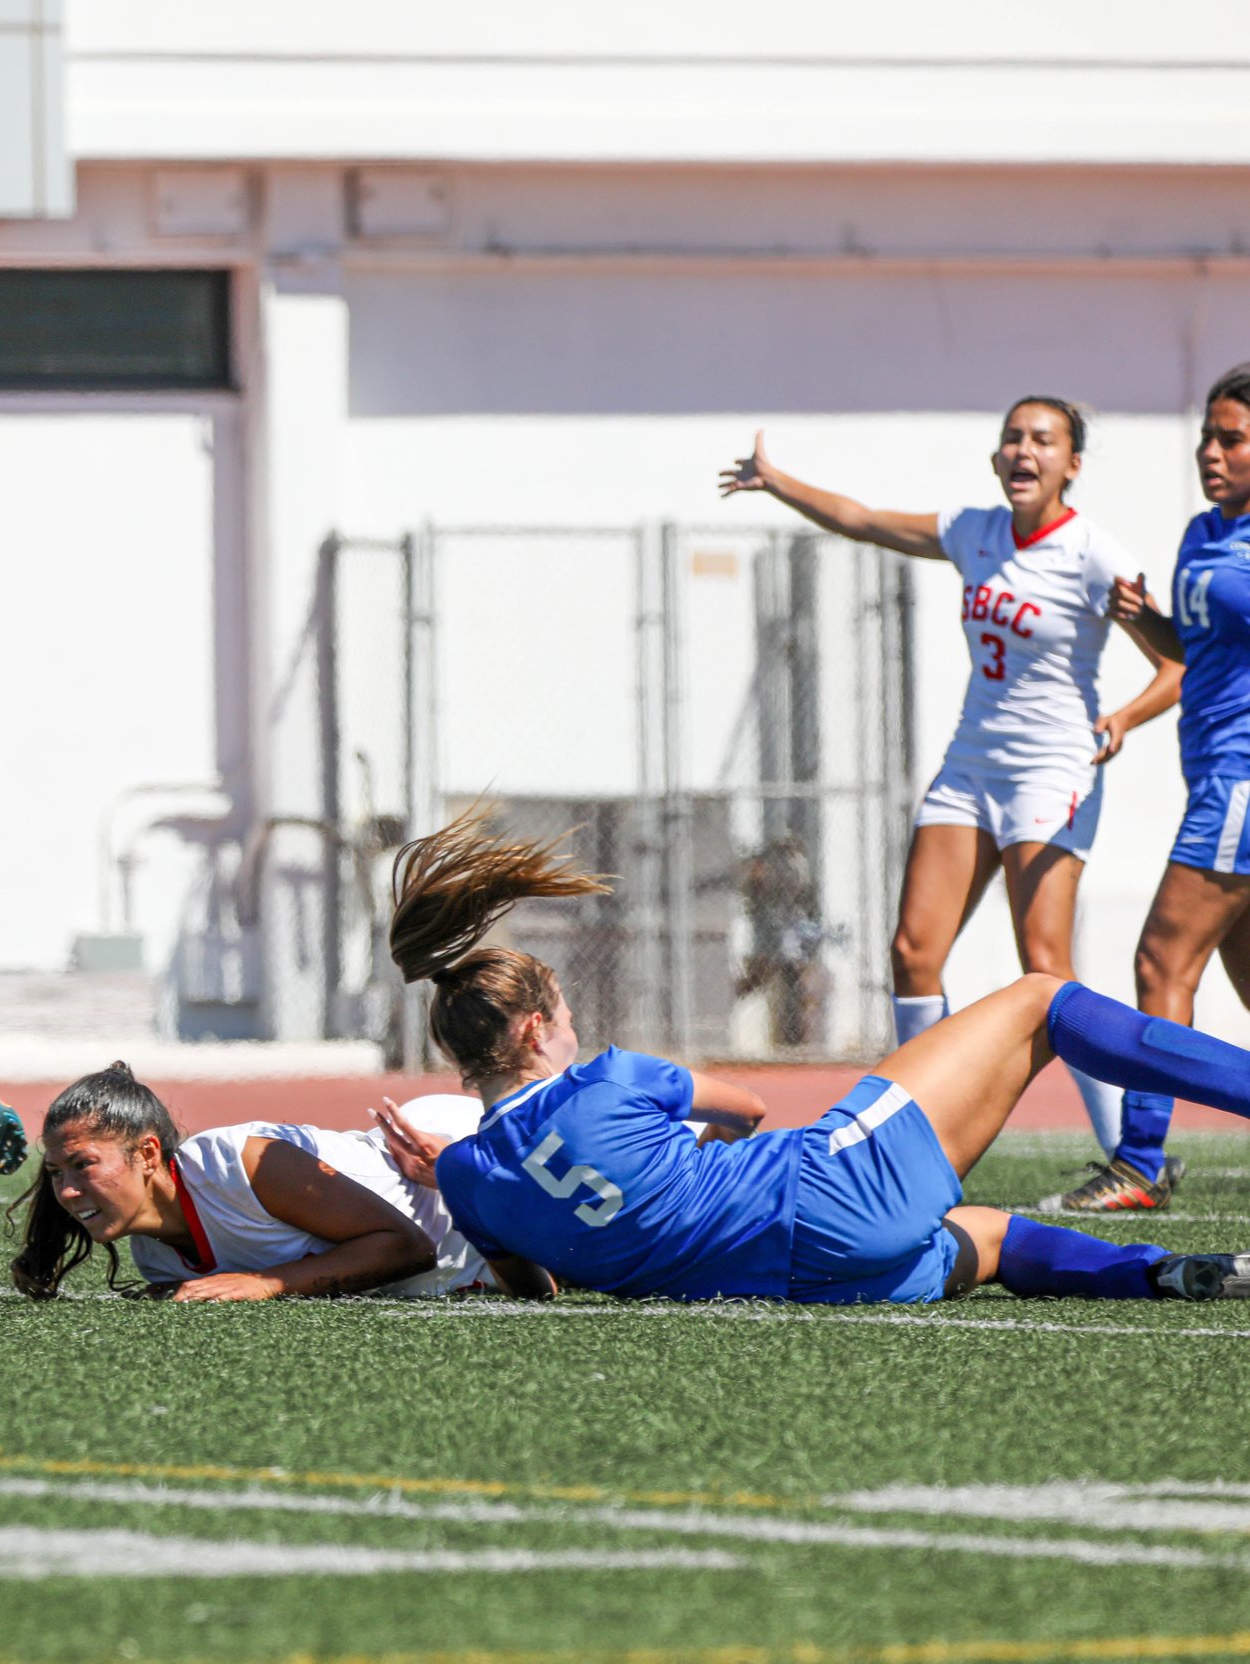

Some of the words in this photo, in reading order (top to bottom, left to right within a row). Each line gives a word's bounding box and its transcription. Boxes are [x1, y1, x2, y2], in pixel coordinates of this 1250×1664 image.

[961, 584, 1042, 638] SBCC
[1178, 568, 1214, 629] 14
[980, 632, 1006, 682] 3
[521, 1130, 624, 1227] 5
